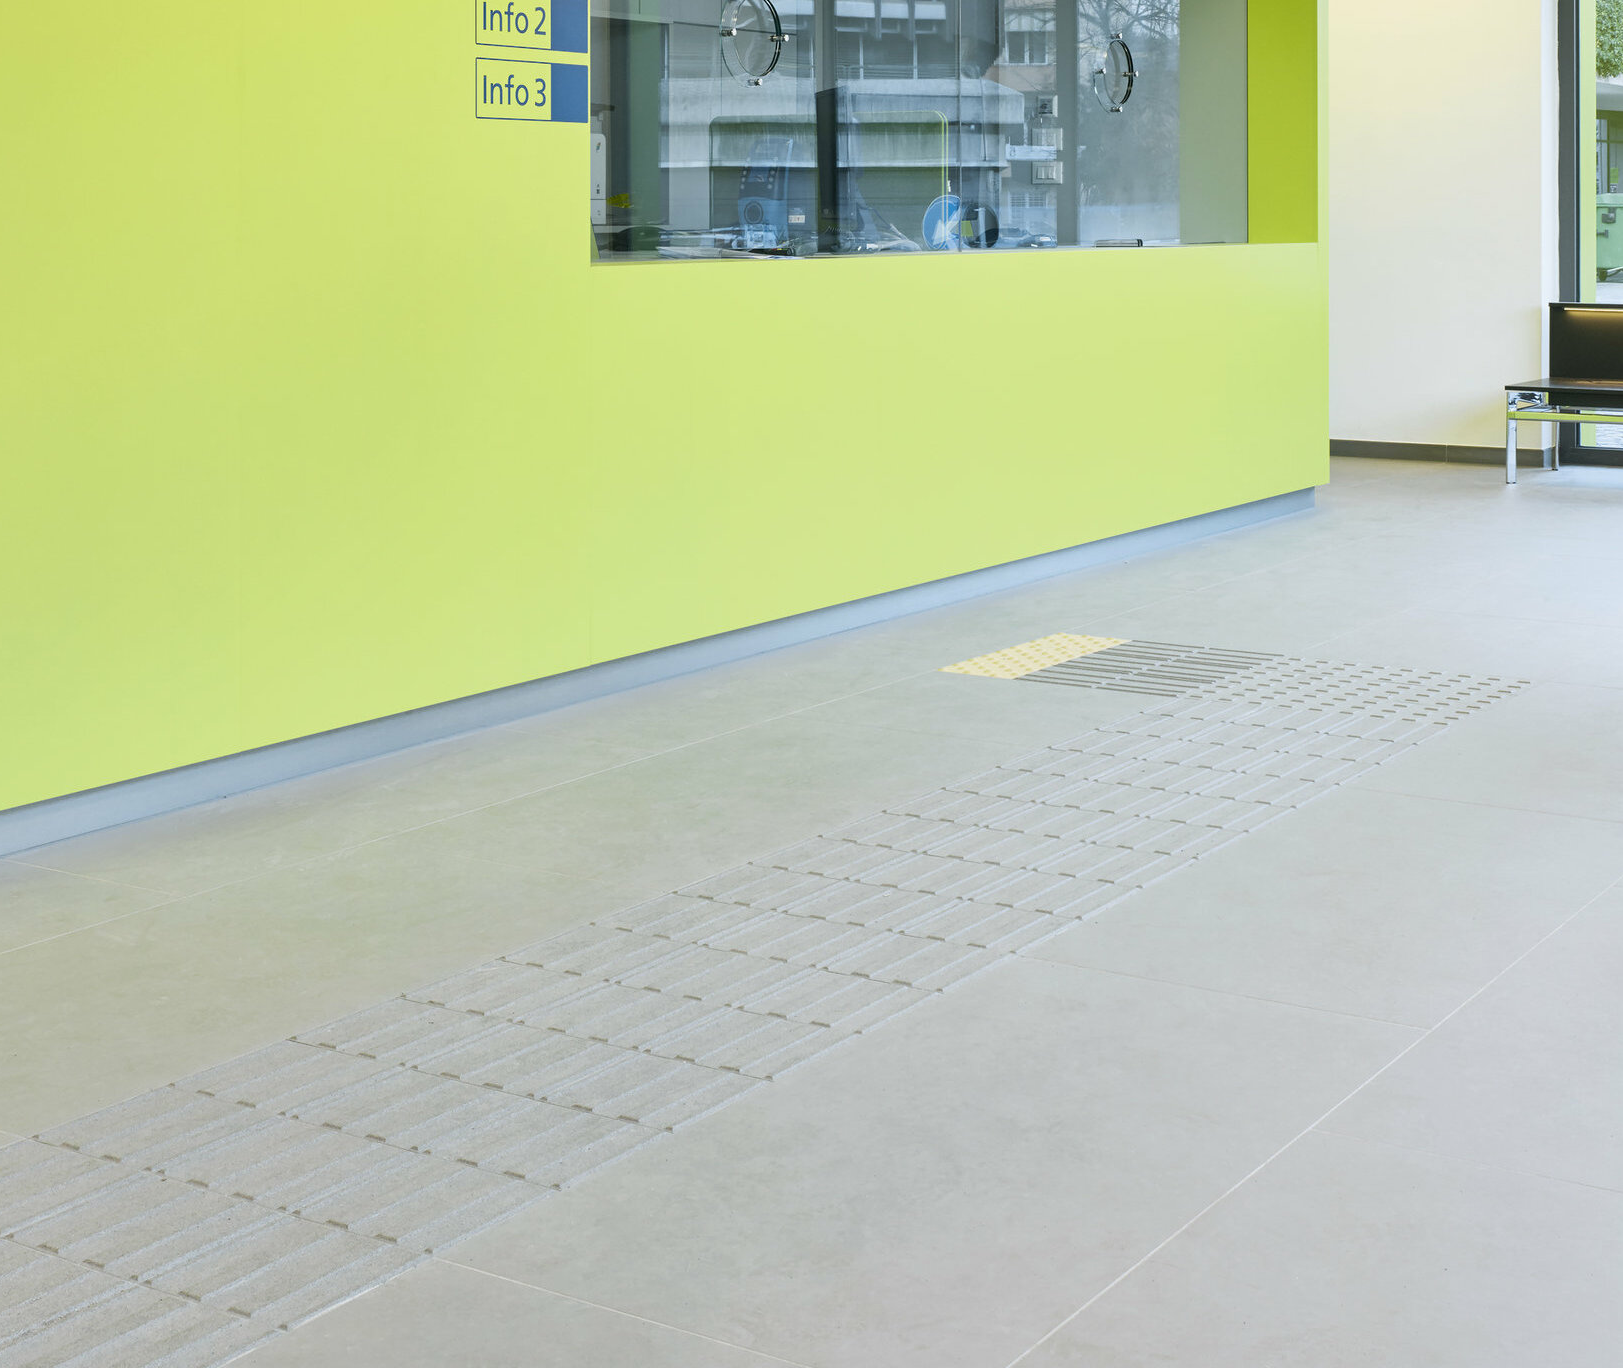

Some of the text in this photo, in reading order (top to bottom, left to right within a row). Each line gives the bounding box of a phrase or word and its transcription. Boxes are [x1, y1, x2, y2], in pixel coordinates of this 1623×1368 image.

[482, 1, 547, 36] Info 2
[482, 74, 547, 107] Info 3
